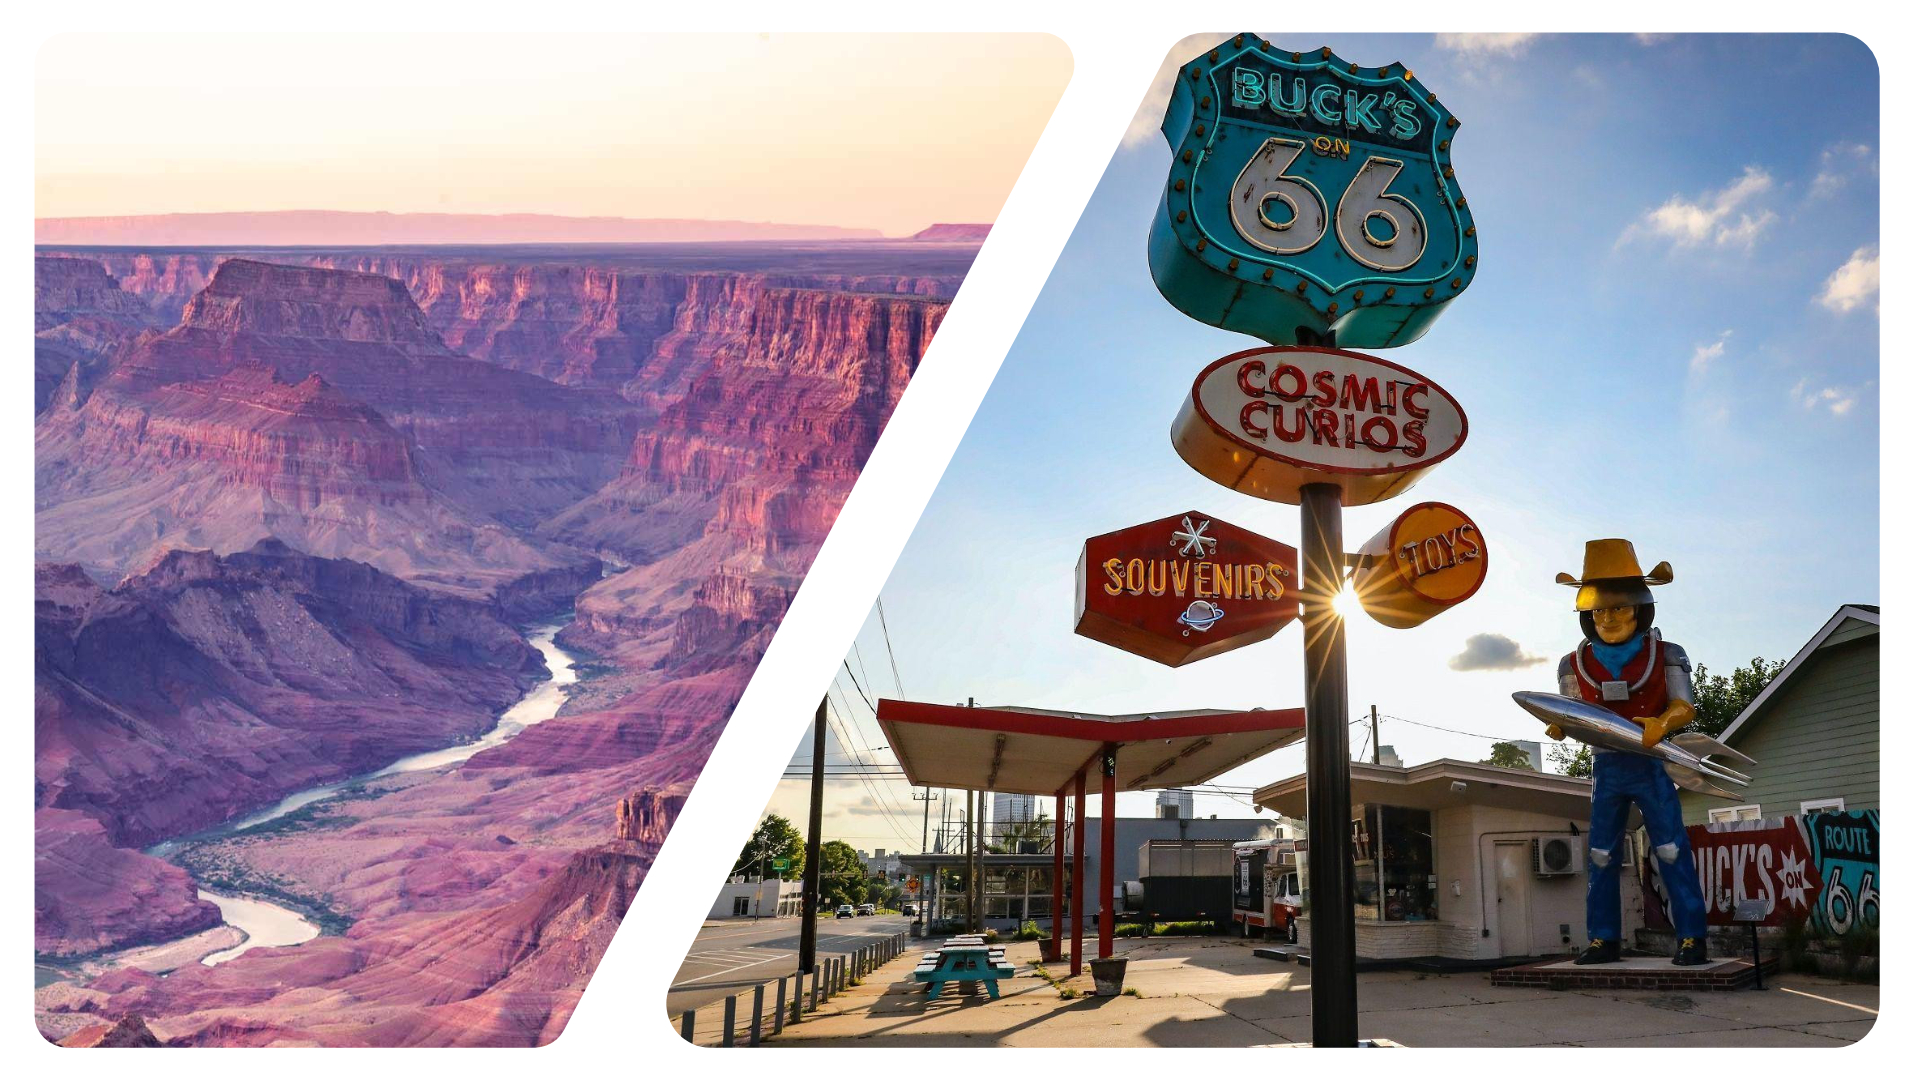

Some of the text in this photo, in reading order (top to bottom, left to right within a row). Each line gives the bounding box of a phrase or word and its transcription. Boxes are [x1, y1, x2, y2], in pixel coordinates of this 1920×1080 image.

[1232, 66, 1422, 141] BUCK'S
[1312, 136, 1350, 161] ON
[1230, 137, 1429, 273] 66
[1236, 360, 1430, 421] COSMIC
[1239, 400, 1429, 459] CURIOS
[1103, 556, 1285, 601] SOUVENIRS
[1402, 522, 1480, 577] TOYS
[1824, 824, 1872, 856] ROUTE
[1692, 843, 1776, 916] UCK'S
[1785, 870, 1802, 890] ON
[1826, 866, 1880, 935] 66
